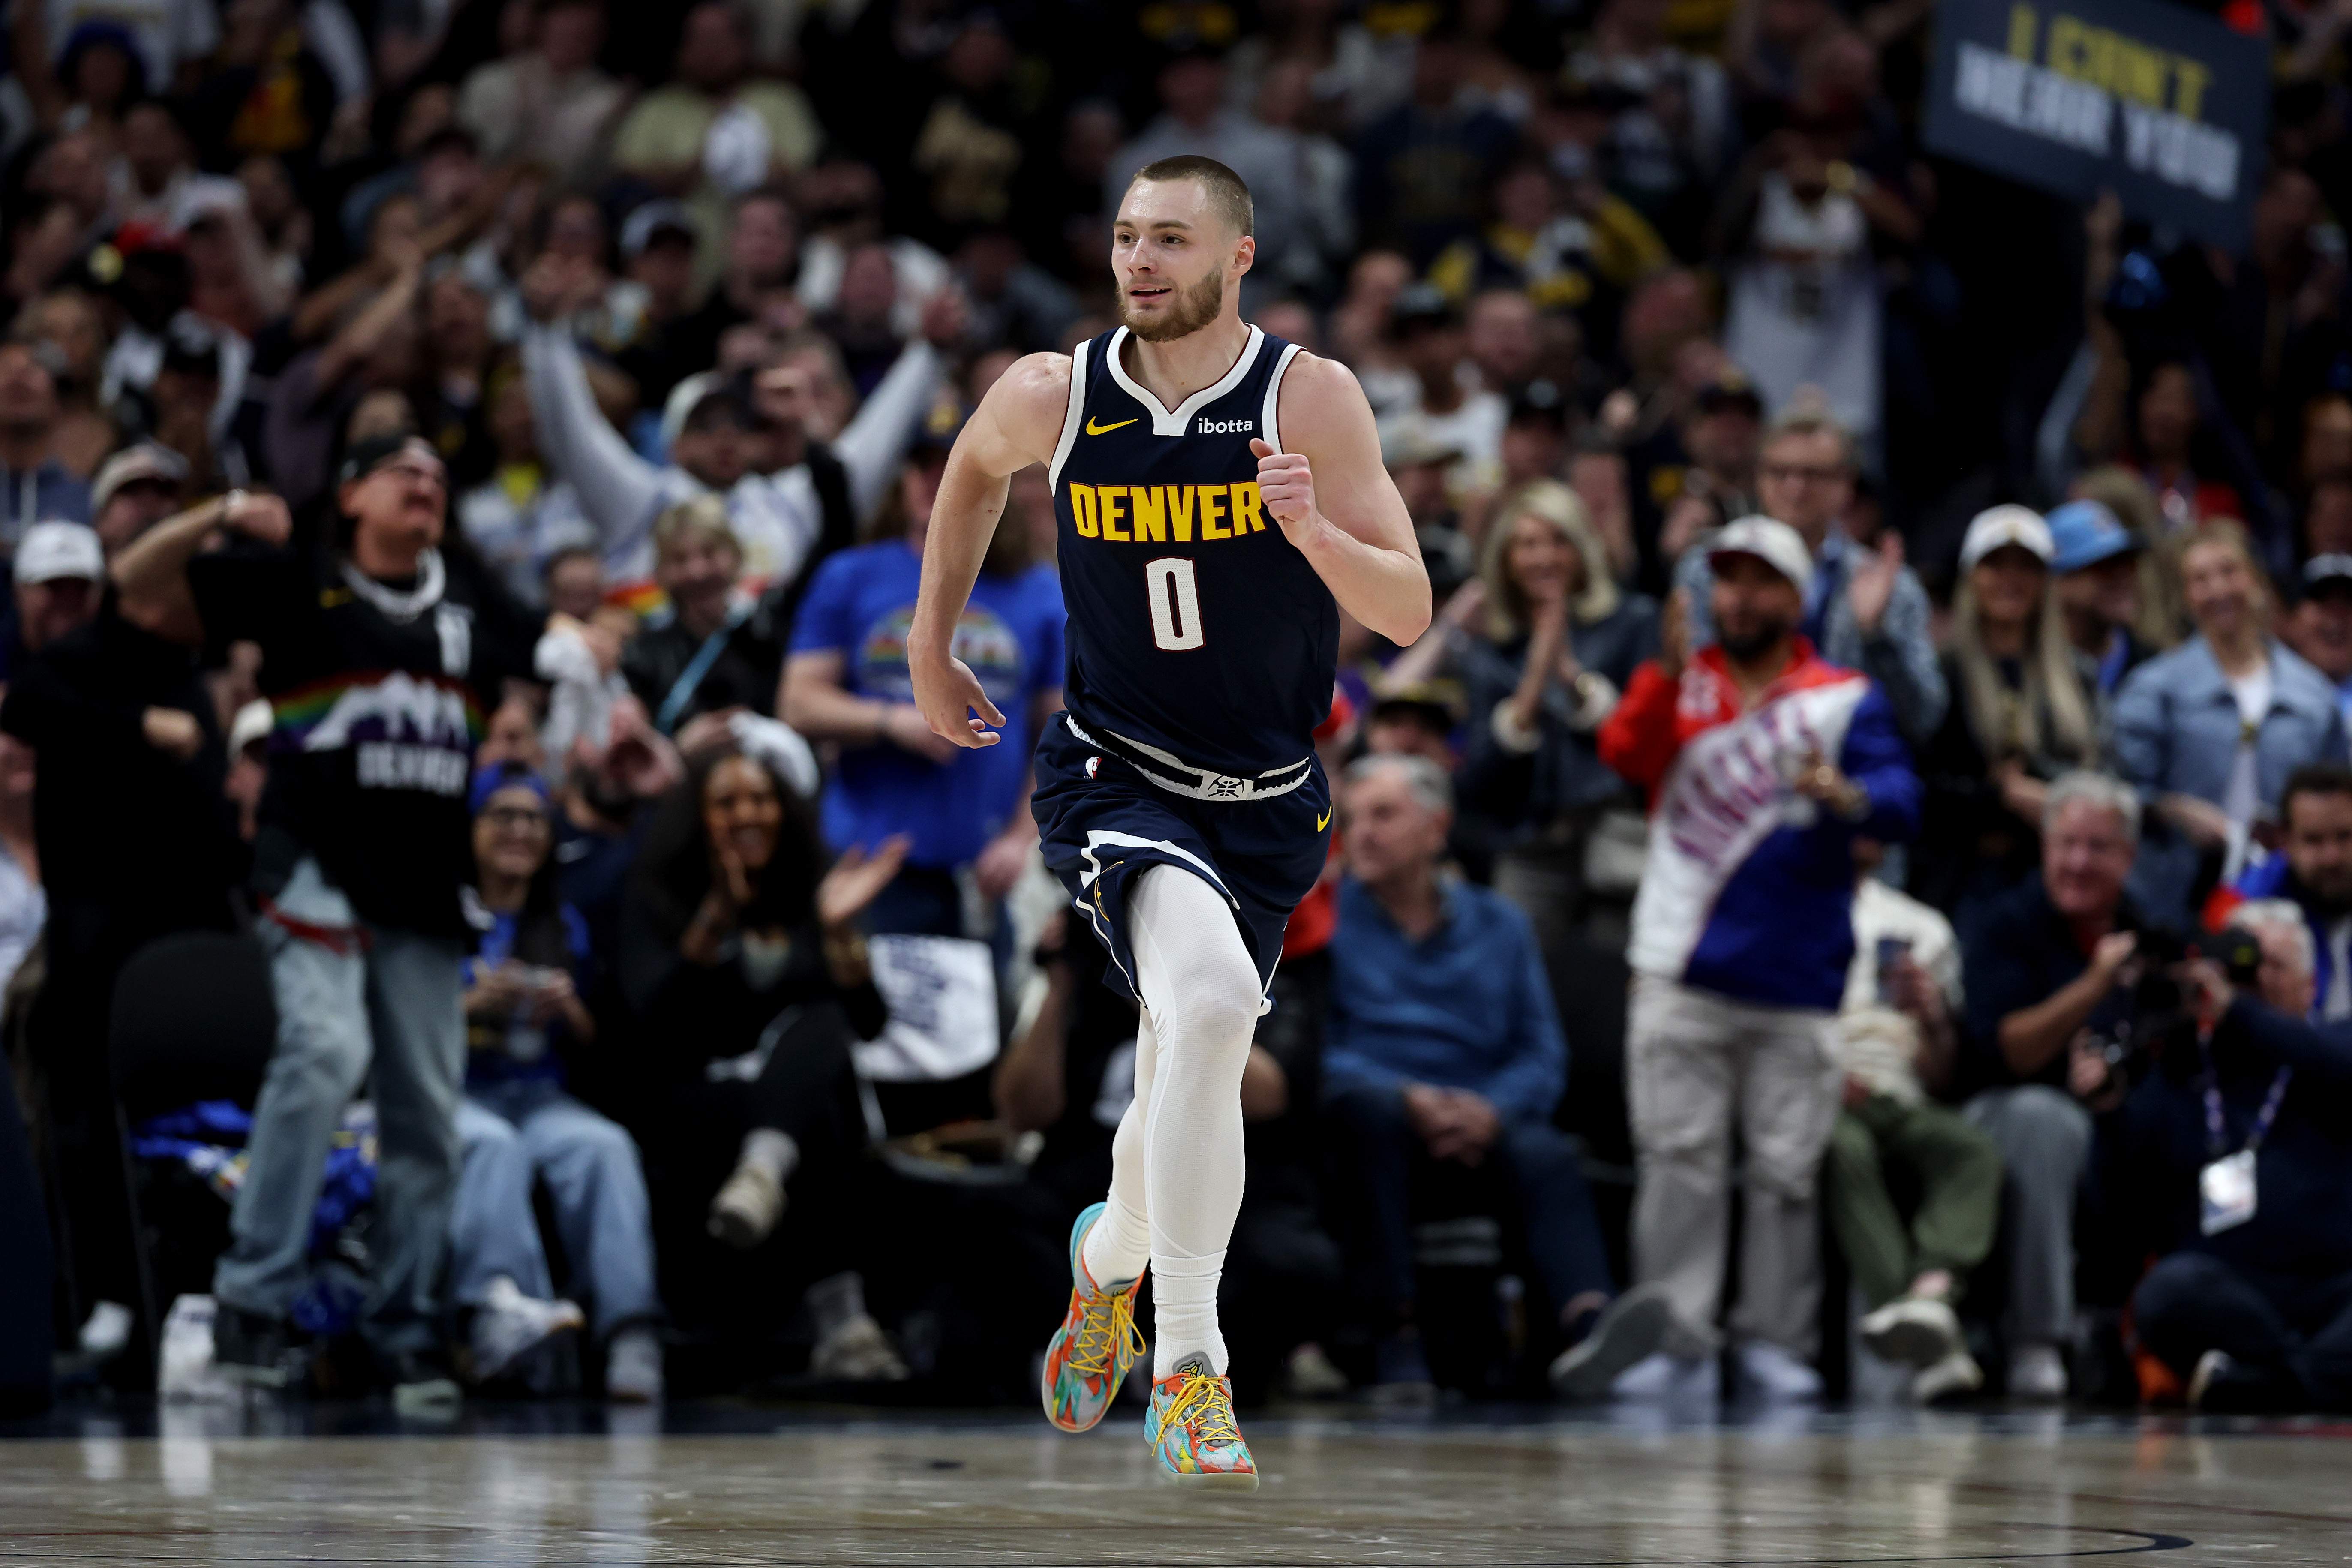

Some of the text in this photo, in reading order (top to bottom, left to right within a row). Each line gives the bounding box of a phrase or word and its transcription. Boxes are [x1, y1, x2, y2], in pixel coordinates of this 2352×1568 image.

[1198, 418, 1252, 433] ibotta
[1069, 481, 1268, 542] DENVER
[1143, 556, 1206, 652] 0
